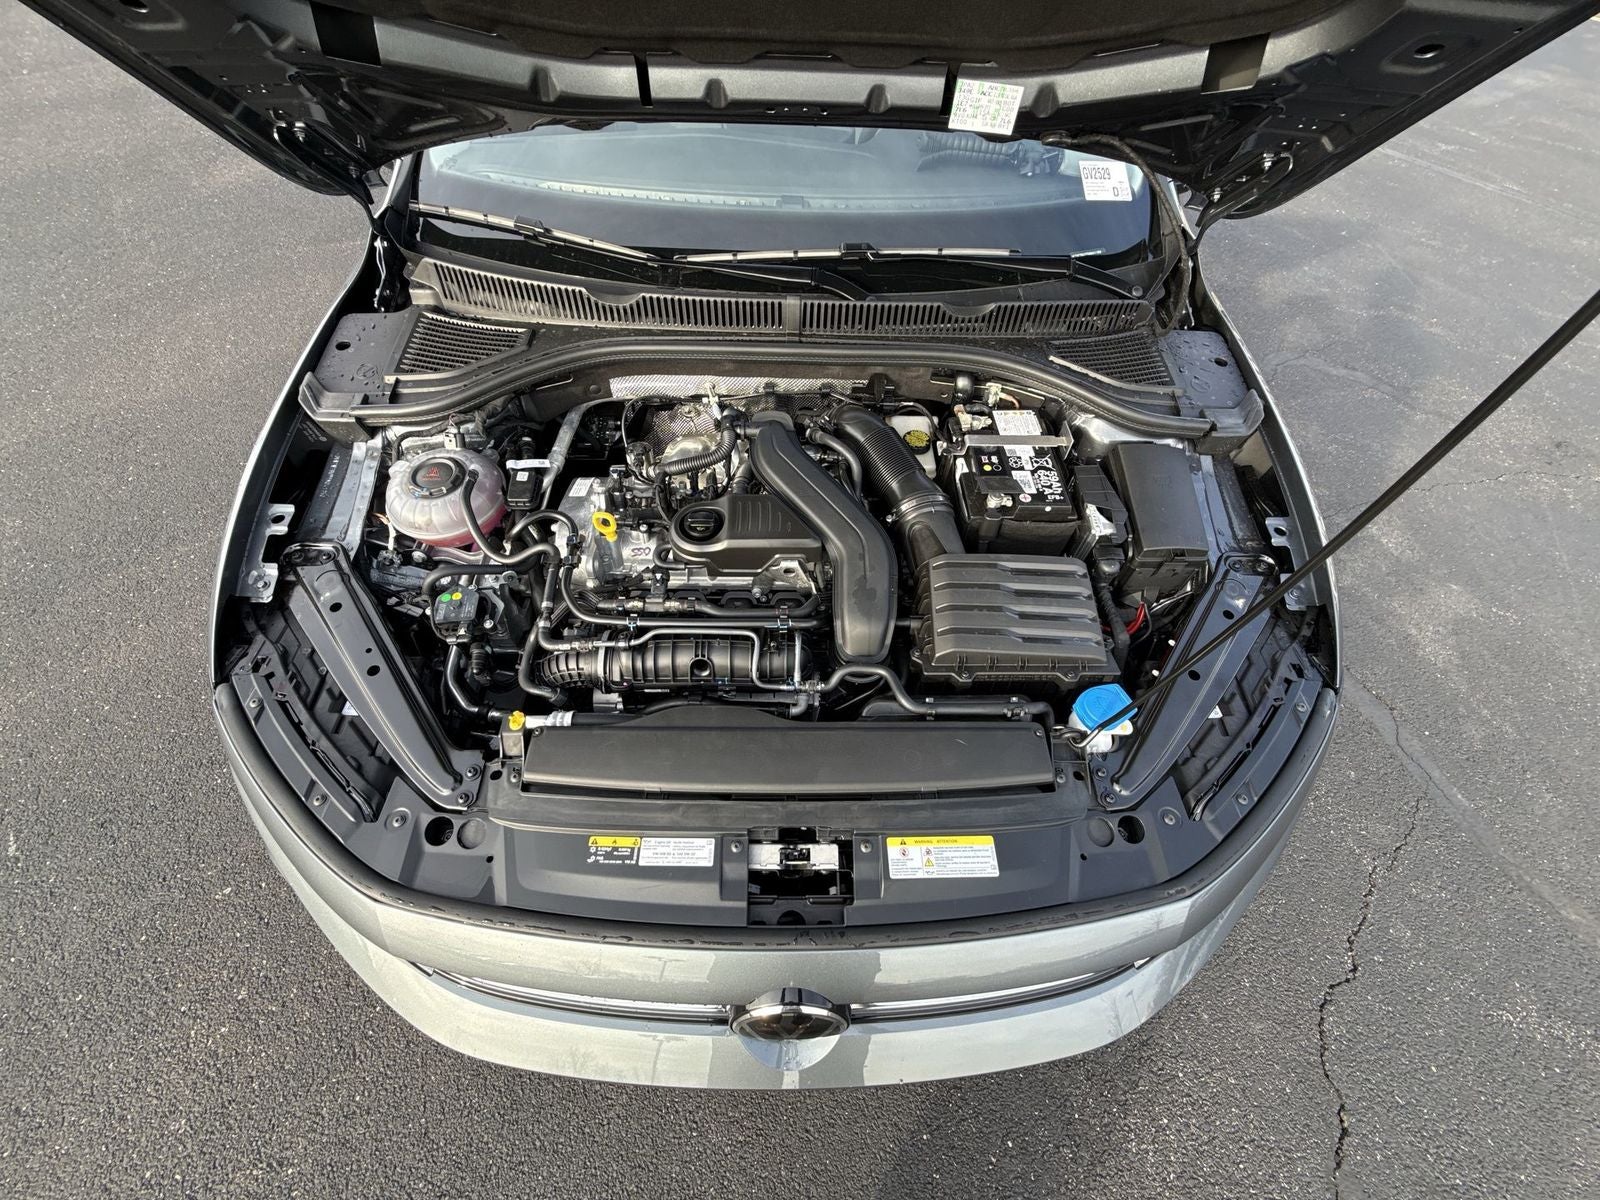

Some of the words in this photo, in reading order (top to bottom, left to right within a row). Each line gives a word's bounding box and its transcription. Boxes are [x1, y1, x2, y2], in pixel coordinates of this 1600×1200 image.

[1082, 166, 1111, 180] GV2529
[1037, 469, 1051, 486] 640
[1046, 470, 1063, 494] 59Ah
